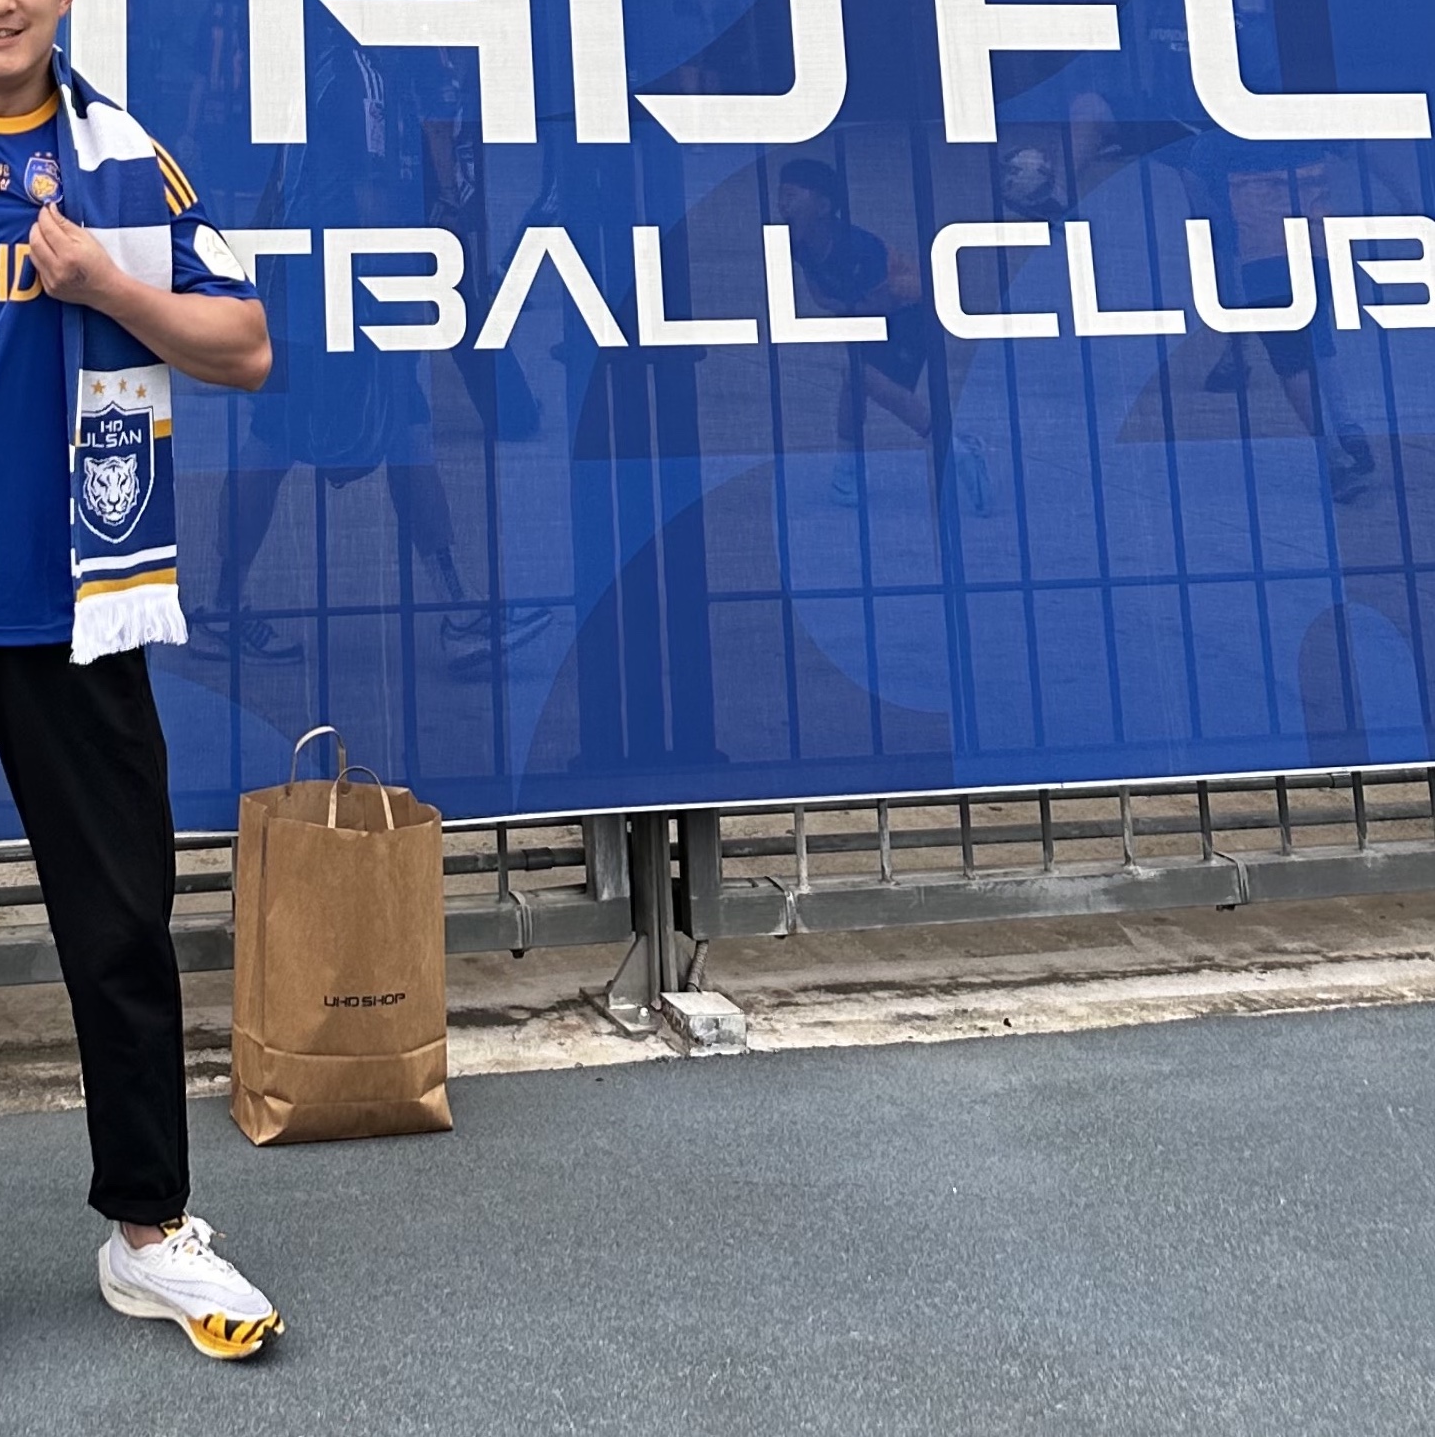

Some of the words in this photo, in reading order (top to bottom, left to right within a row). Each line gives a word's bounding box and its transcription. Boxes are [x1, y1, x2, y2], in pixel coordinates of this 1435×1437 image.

[930, 215, 1435, 340] CLUB
[100, 419, 123, 434] HD
[361, 992, 406, 1008] SHOP
